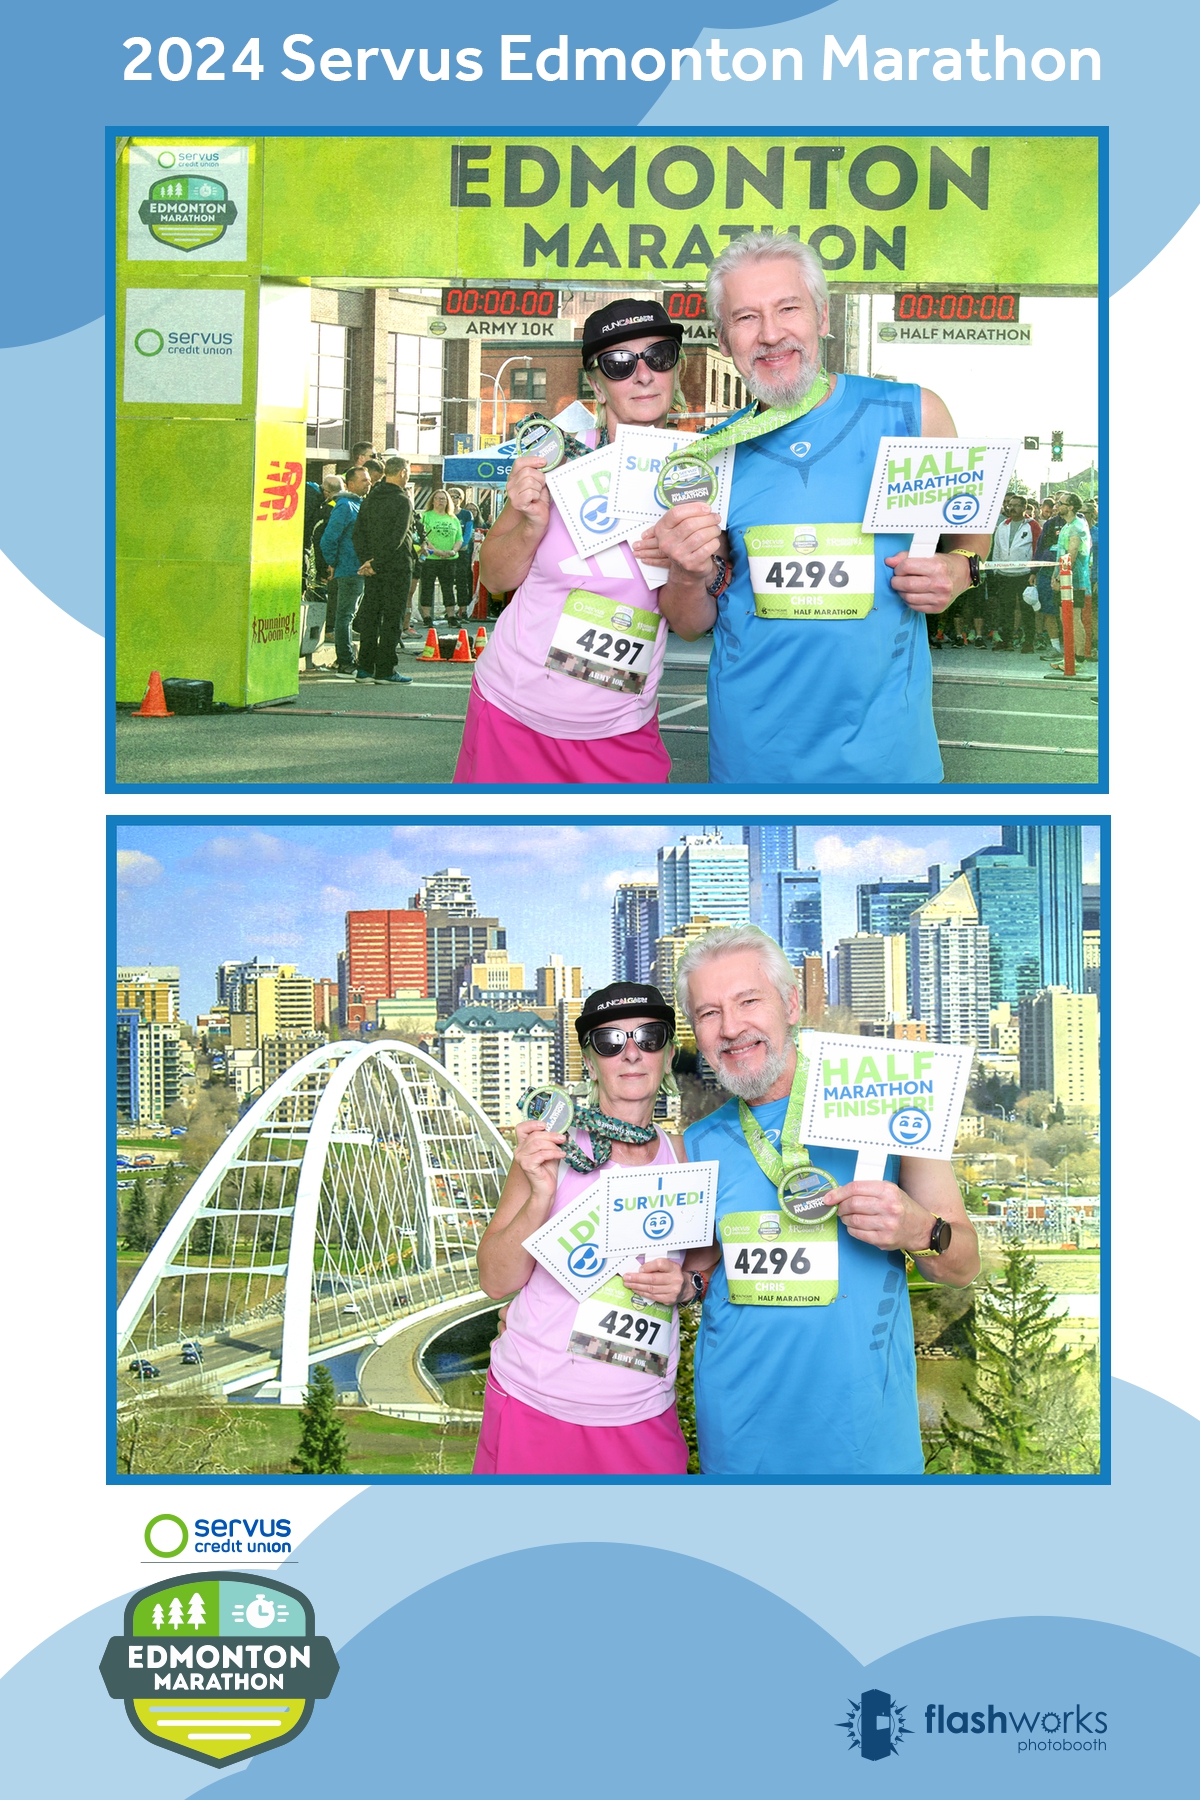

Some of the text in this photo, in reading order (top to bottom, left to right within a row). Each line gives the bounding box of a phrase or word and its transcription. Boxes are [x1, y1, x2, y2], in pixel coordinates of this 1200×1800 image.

[178, 153, 219, 161] servus
[450, 144, 990, 210] EDMONTON
[149, 203, 227, 213] EDMONTON
[160, 214, 215, 222] MARATHON
[466, 321, 554, 336] ARMY 10K
[900, 328, 1030, 341] HALF MARATHON
[168, 332, 233, 345] servus
[168, 345, 233, 355] credit union
[888, 446, 987, 483] HALF
[887, 470, 984, 495] MARATHON
[887, 483, 984, 510] FINISHER!
[765, 561, 849, 588] 4296
[790, 596, 824, 605] CHRIS
[576, 628, 644, 665] 4297
[589, 671, 611, 683] ARMY
[822, 1051, 934, 1086] HALF
[824, 1080, 933, 1101] MARATHON
[824, 1095, 934, 1118] FINISHER!
[657, 1177, 663, 1190] I
[613, 1191, 704, 1212] SURVIVED!
[734, 1248, 811, 1274] 4296
[755, 1282, 785, 1291] CHRIS
[598, 1310, 661, 1346] 4297
[612, 1352, 633, 1363] ARMY
